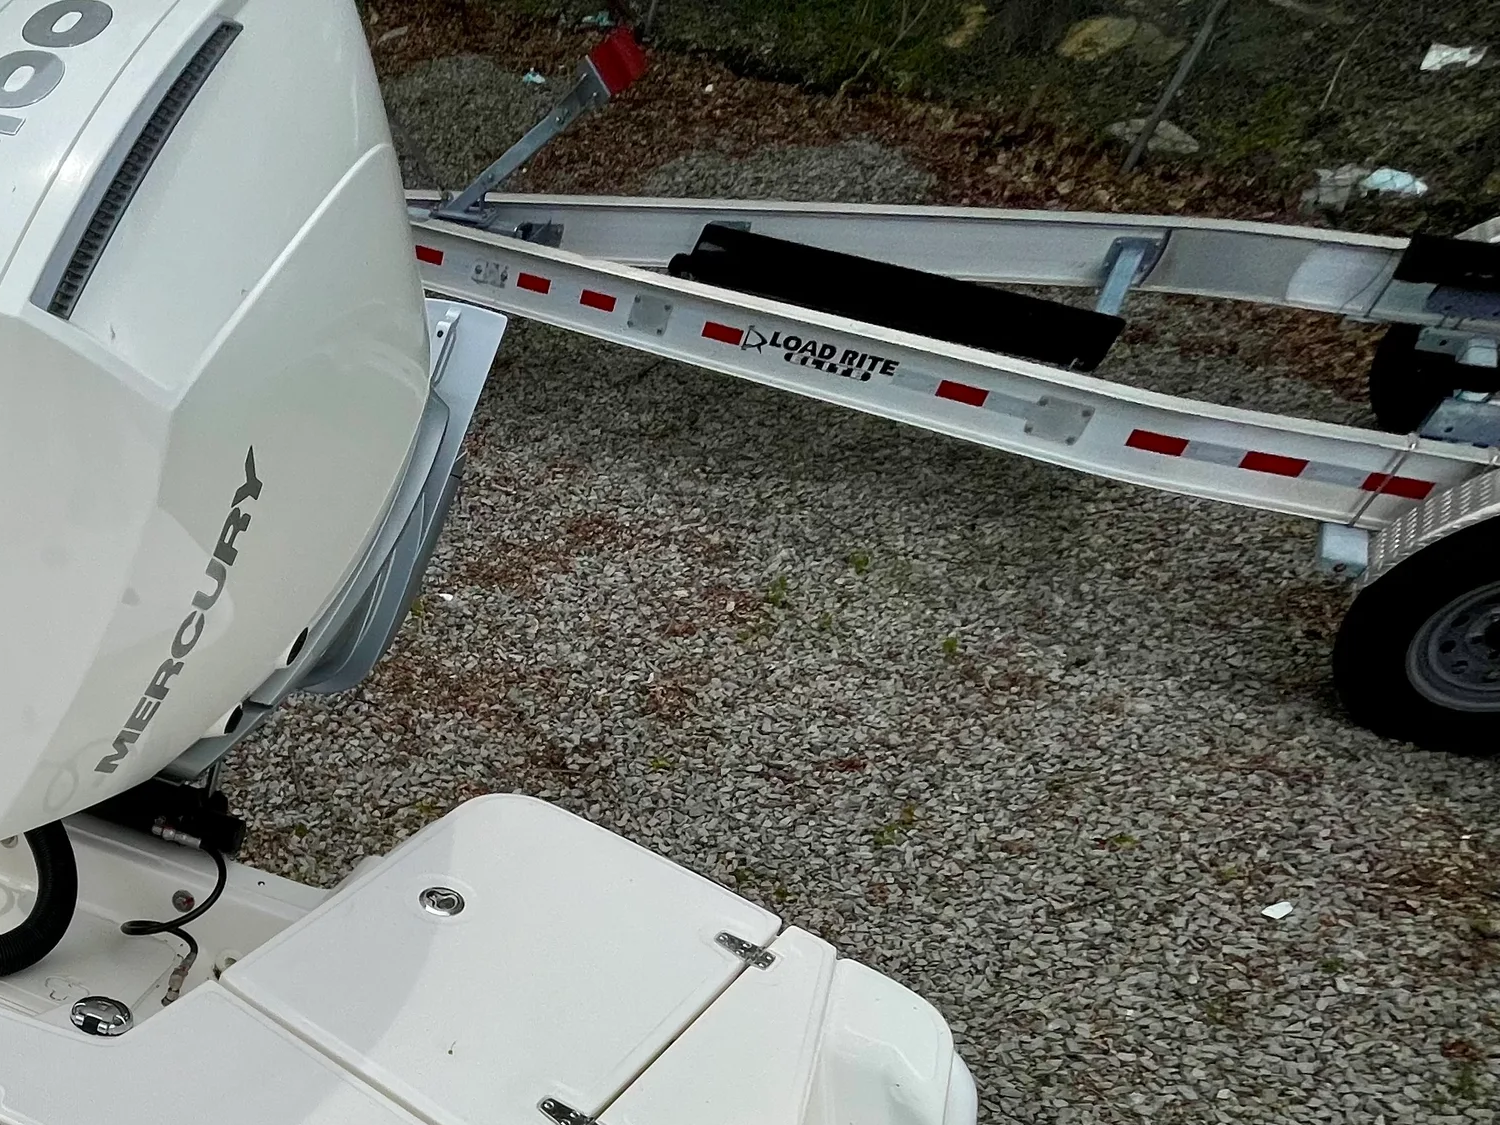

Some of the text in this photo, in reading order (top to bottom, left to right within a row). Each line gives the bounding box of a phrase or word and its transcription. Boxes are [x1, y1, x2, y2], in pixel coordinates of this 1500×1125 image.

[769, 331, 900, 377] LOAD RITE
[94, 445, 263, 774] MERCURY
